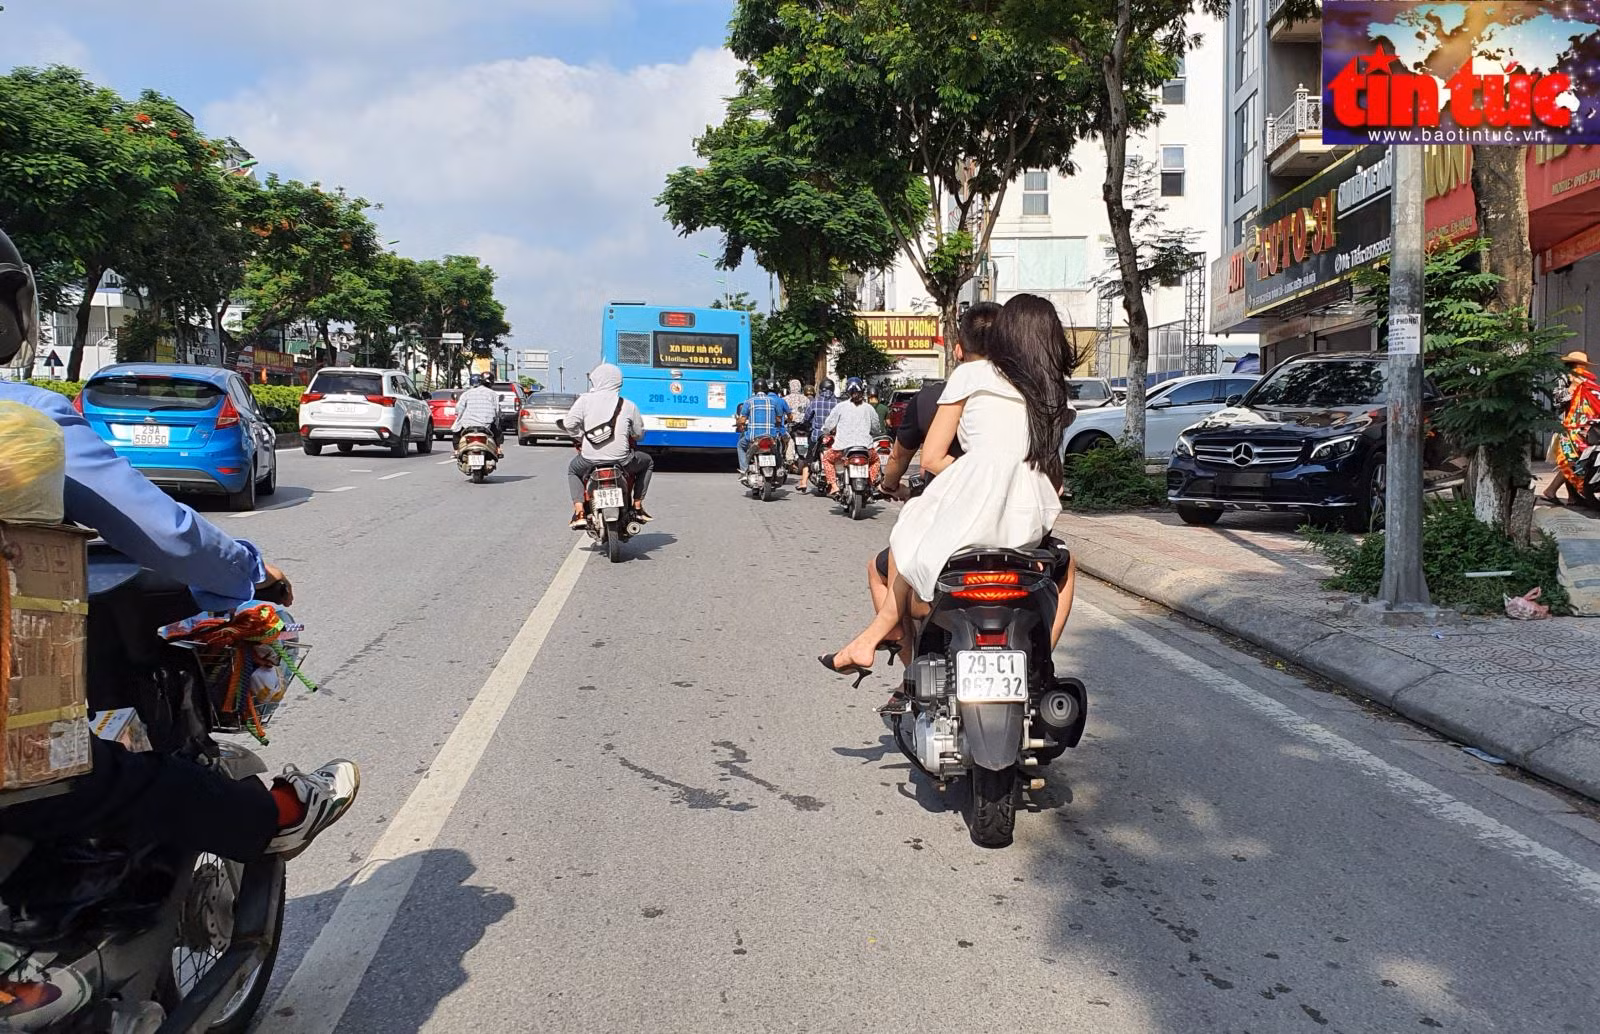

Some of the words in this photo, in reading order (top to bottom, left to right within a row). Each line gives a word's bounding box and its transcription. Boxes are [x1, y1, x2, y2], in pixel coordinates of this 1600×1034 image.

[1256, 207, 1308, 281] AUTO
[1311, 189, 1336, 255] 31
[868, 317, 888, 337] THUÊ
[889, 316, 907, 337] VĂN
[909, 316, 937, 337] PHÒNG
[890, 339, 905, 349] 111
[908, 339, 930, 349] 9368
[649, 394, 664, 403] 29B
[673, 395, 699, 404] 192.93
[142, 425, 160, 435] 29A
[135, 434, 167, 444] 590.50
[968, 655, 1015, 674] 29-C1
